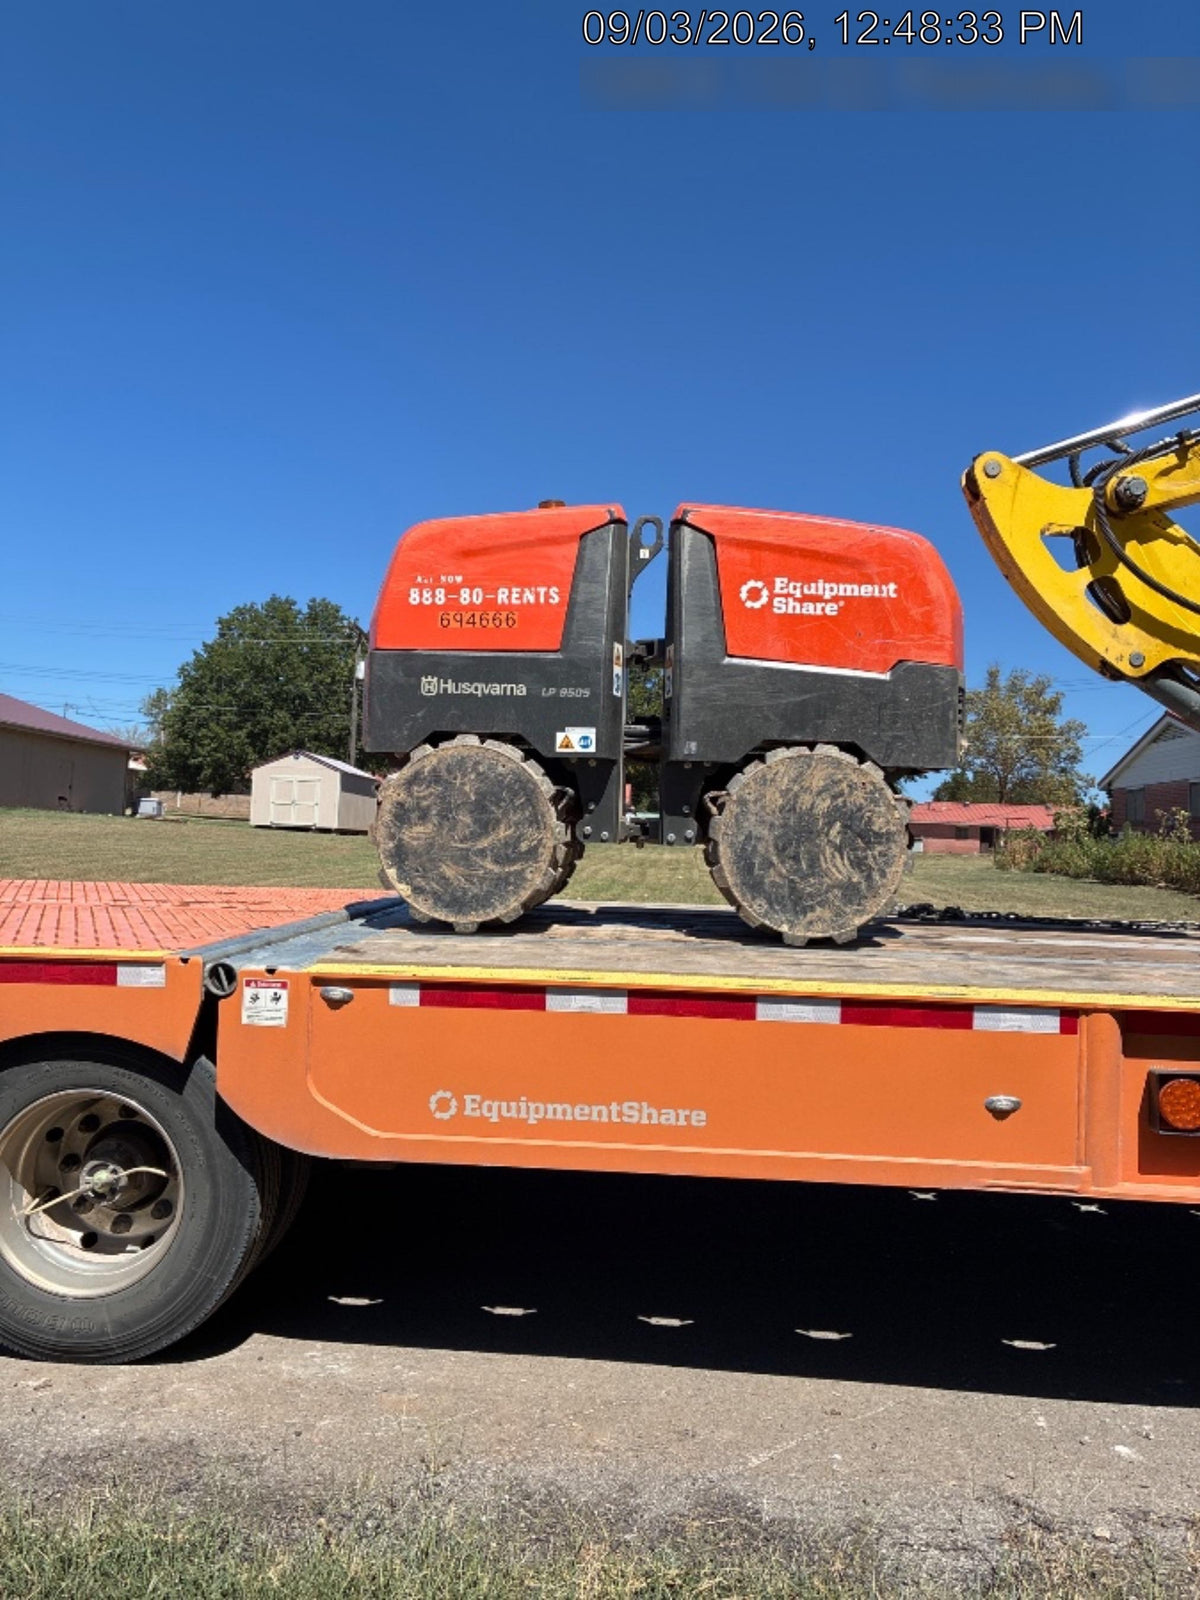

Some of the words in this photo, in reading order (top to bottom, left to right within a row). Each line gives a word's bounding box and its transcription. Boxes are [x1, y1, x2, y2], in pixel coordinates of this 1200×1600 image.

[408, 586, 561, 606] 888-80-RENTS
[773, 577, 898, 598] Equipment
[439, 611, 518, 628] 694666
[438, 679, 527, 698] Husqvarna
[463, 1093, 707, 1127] EquipmentShare
